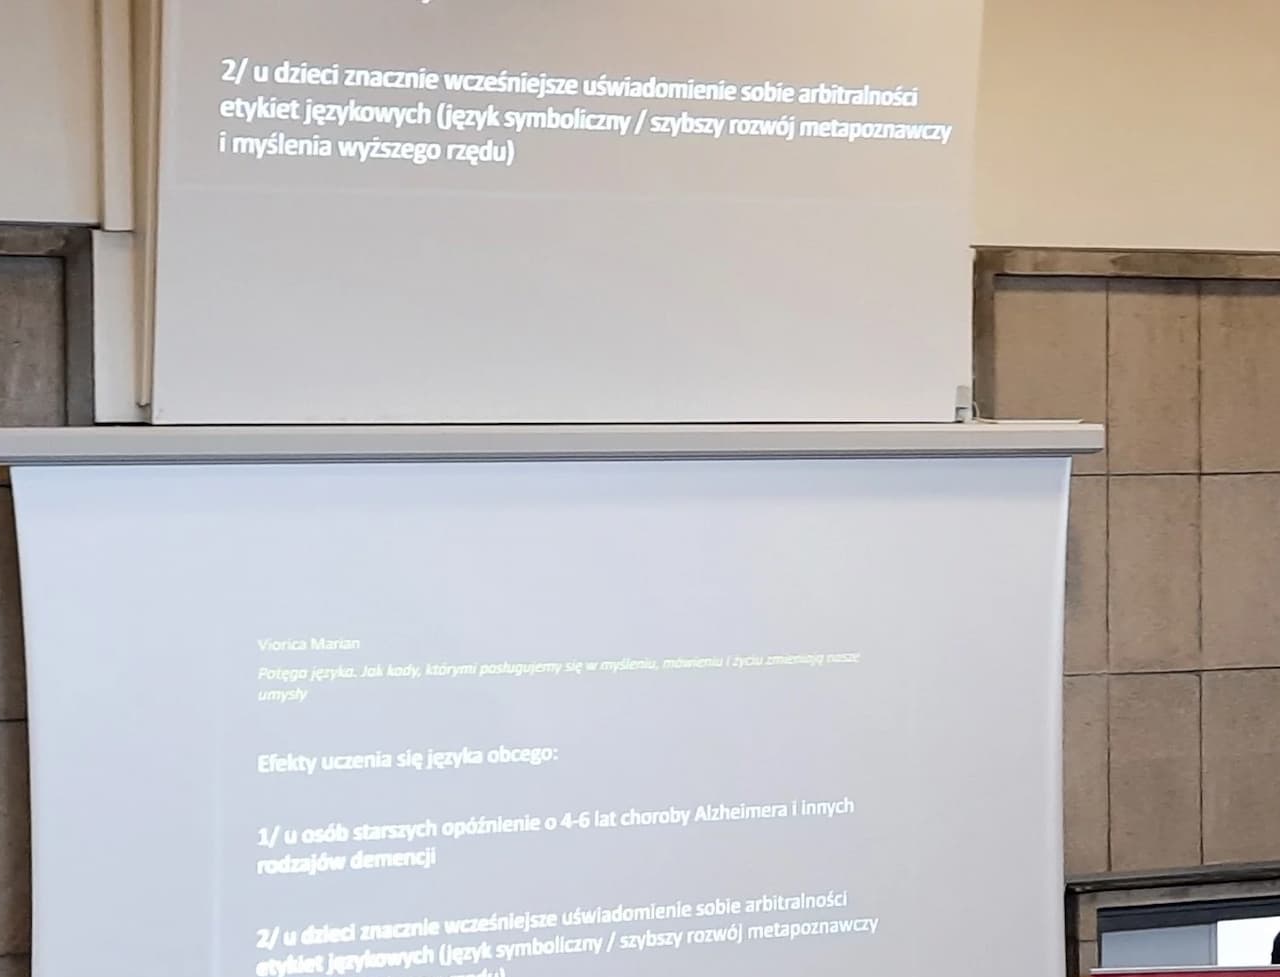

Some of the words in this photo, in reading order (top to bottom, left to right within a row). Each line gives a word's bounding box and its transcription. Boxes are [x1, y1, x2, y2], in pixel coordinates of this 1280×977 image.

[222, 58, 248, 84] 2/
[254, 66, 268, 82] u
[275, 61, 339, 84] dzieci
[344, 68, 439, 89] znacznie
[444, 70, 578, 98] wcześniejsze
[583, 74, 737, 100] uświadomienie
[741, 81, 795, 102] sobie
[799, 83, 918, 106] arbitralności
[220, 96, 300, 122] etykiet
[303, 99, 431, 128] językowych
[437, 103, 500, 130] (język
[504, 107, 631, 135] symboliczny
[650, 112, 726, 138] szybszy
[729, 116, 795, 140] rozwój
[800, 120, 952, 144] metapoznawczy
[233, 133, 331, 159] myślenia
[338, 137, 441, 164] wyższego
[447, 140, 514, 166] rzędu)
[258, 753, 317, 775] Efekty
[322, 751, 392, 770] uczenia
[397, 749, 423, 770] się
[426, 747, 483, 769] języka
[487, 745, 558, 765] obcego:
[257, 825, 280, 848] 1/
[284, 830, 297, 844] u
[301, 823, 349, 843] osób
[353, 819, 437, 841] starszych
[442, 814, 541, 838] opóźnienie
[544, 817, 557, 830] o
[560, 812, 590, 828] 4-6
[595, 810, 617, 827] lat
[620, 806, 691, 826] choroby
[694, 803, 787, 821] Alzheimera
[802, 797, 854, 817] innych
[257, 852, 346, 875] rodzajów
[350, 847, 436, 869] demencji
[256, 926, 280, 950] 2/
[284, 930, 297, 946] u
[301, 923, 355, 944] dzieci
[360, 918, 440, 940] znacznie
[444, 912, 557, 934] wcześniejsze
[562, 901, 692, 925] uświadomienie
[696, 898, 741, 916] sobie
[745, 890, 847, 912] arbitralności
[326, 946, 434, 974] językowych
[439, 941, 492, 966] (język
[496, 936, 603, 961] symboliczny
[620, 929, 683, 951] szybszy
[687, 923, 742, 944] rozwój
[748, 918, 879, 940] metapoznawczy
